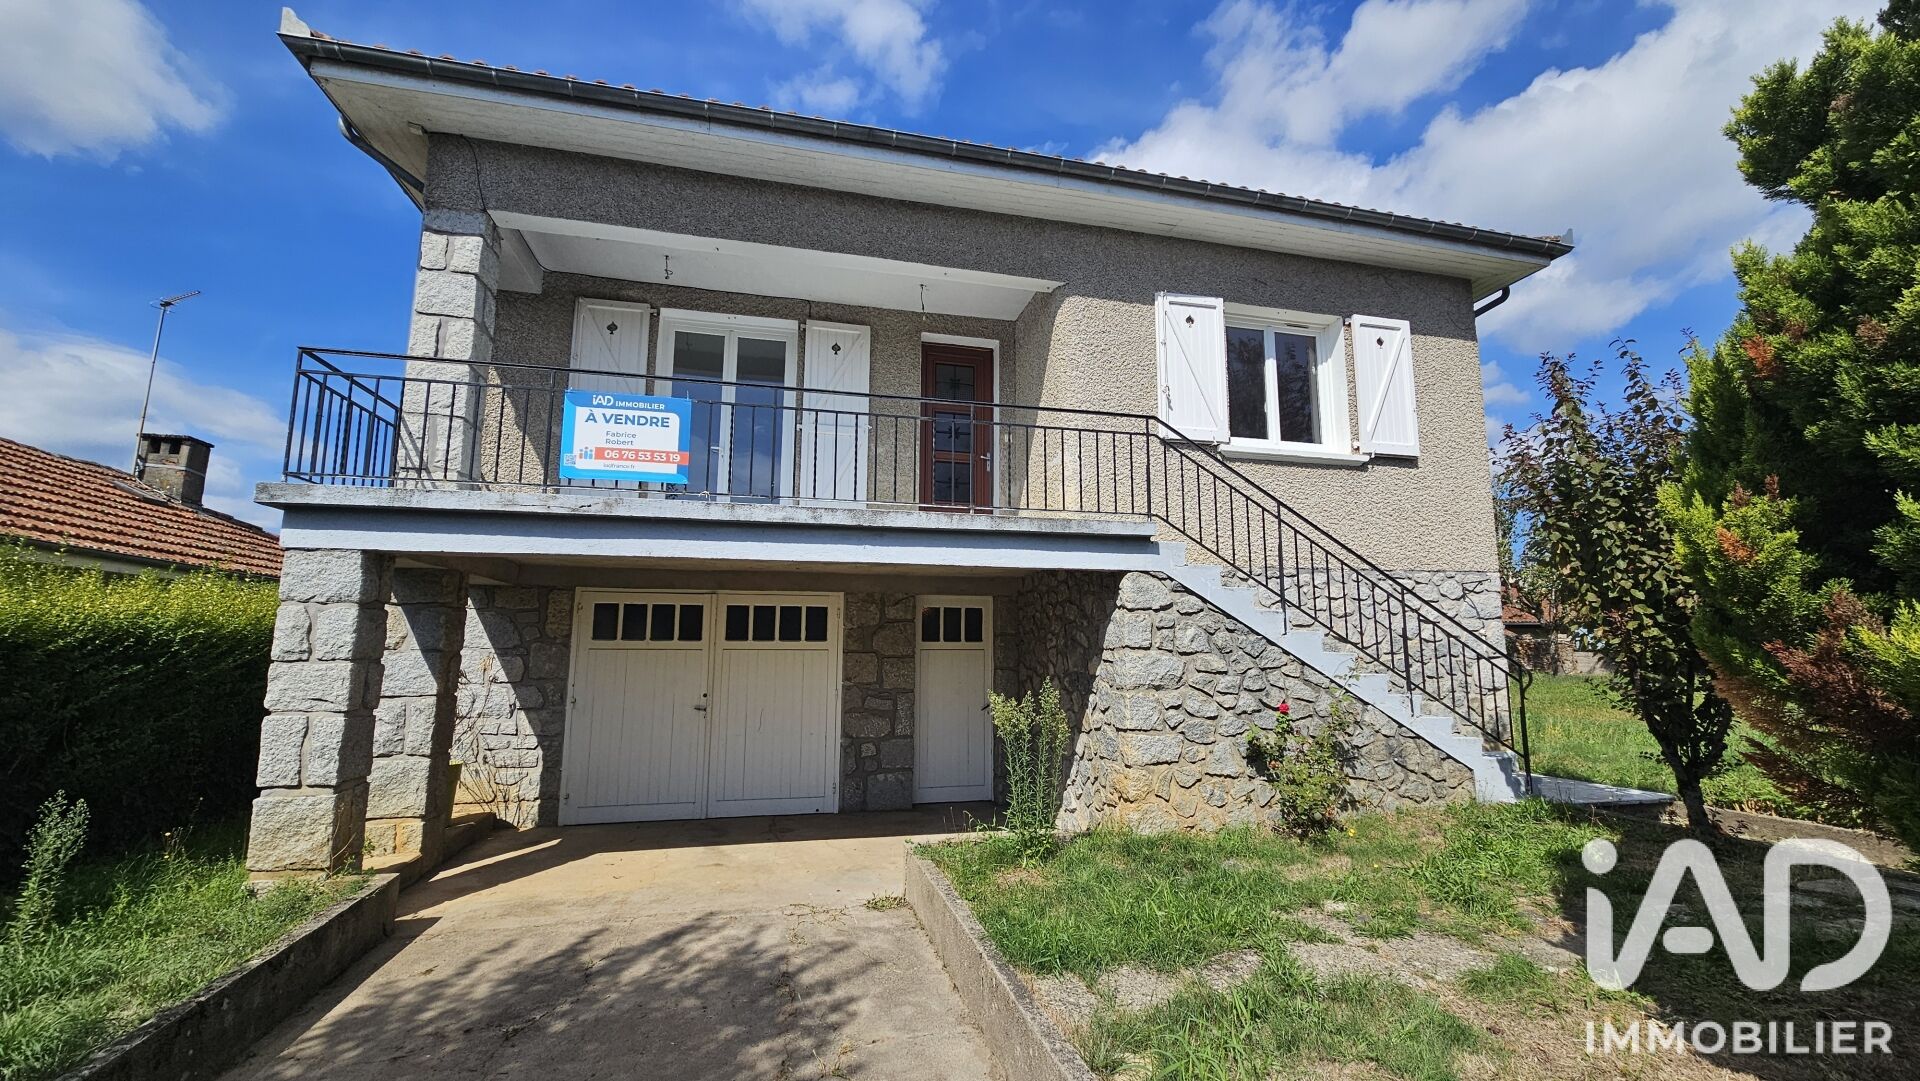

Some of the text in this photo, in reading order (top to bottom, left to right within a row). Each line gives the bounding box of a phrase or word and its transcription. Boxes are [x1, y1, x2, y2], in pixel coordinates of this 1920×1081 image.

[615, 401, 665, 410] IMMOBILIER
[585, 409, 670, 427] À VENDRE
[606, 430, 637, 439] Fabrice
[605, 438, 634, 446] Robert
[604, 450, 681, 462] 06 76 53 53 19
